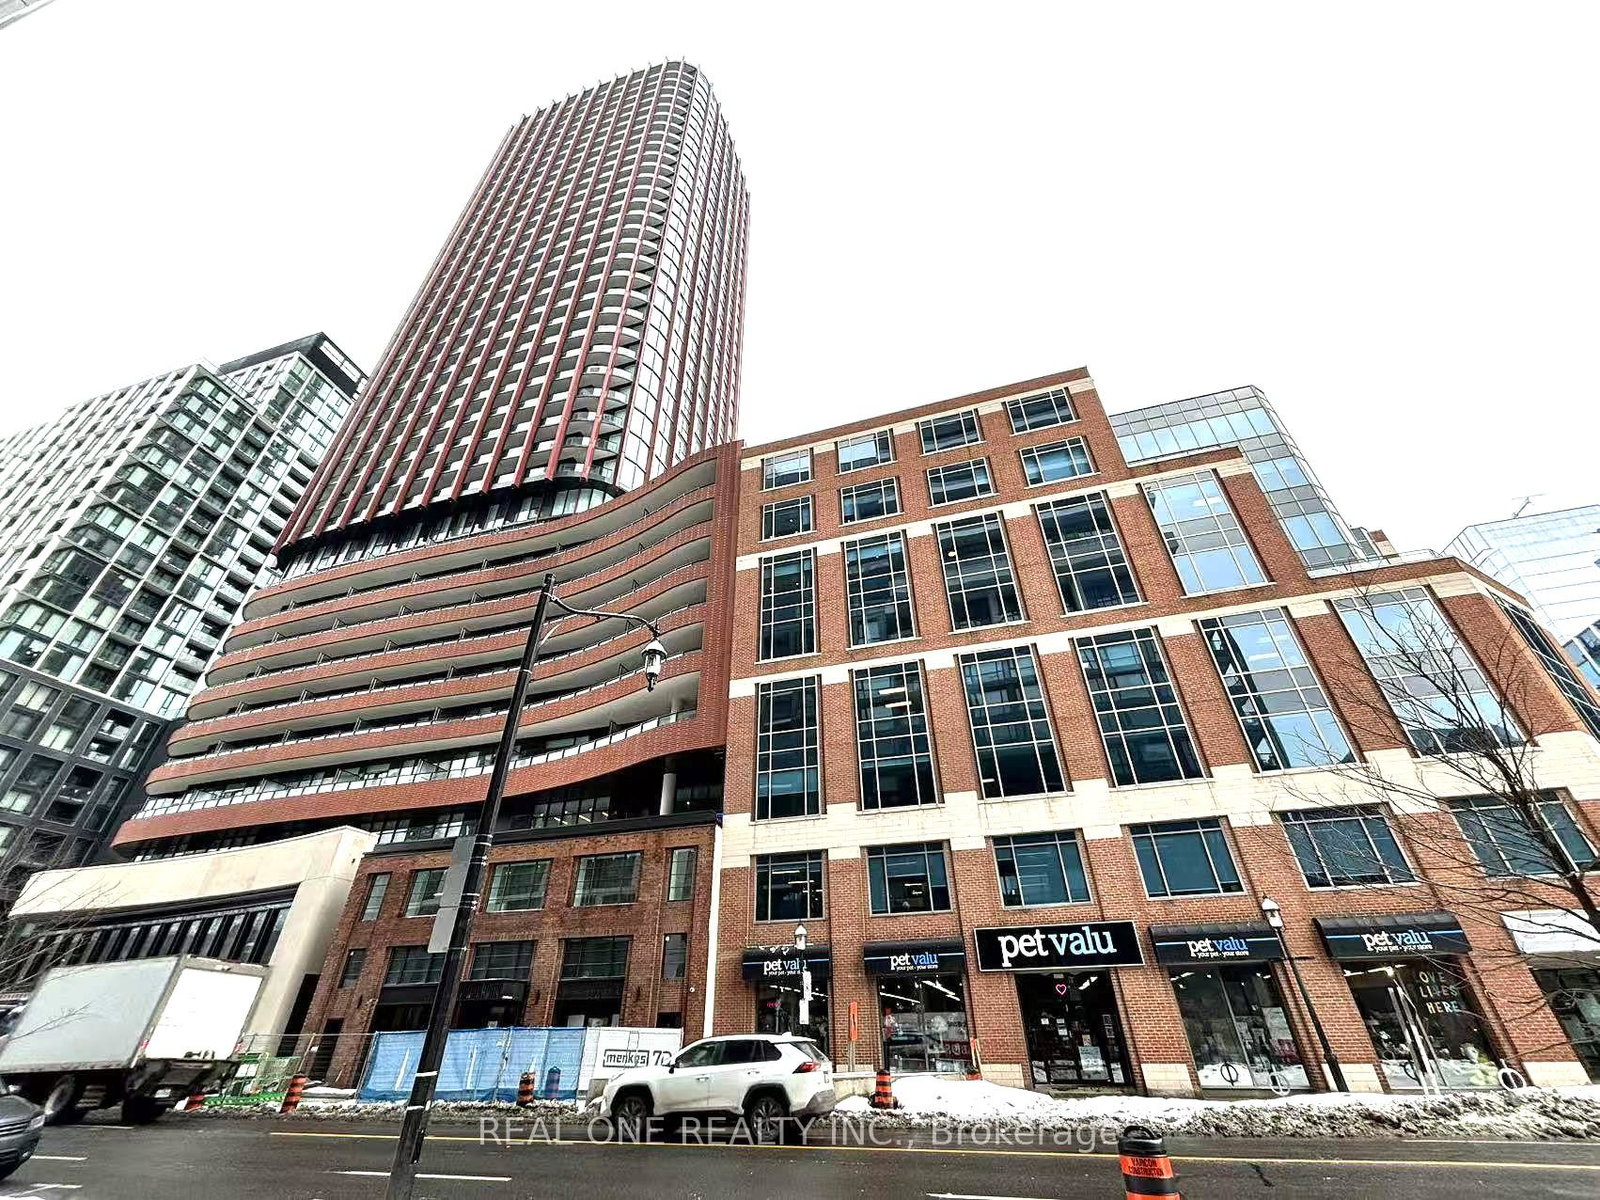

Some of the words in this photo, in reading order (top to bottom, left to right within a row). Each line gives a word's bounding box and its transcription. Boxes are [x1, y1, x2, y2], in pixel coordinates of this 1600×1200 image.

[997, 928, 1049, 968] pet
[1048, 925, 1117, 956] valu
[1186, 938, 1214, 957] pet
[1212, 936, 1248, 951] valu
[1361, 930, 1392, 952] pet
[1390, 929, 1431, 945] valu
[763, 958, 782, 976] pet
[889, 952, 911, 971] pet
[910, 951, 939, 965] valu
[1415, 971, 1446, 983] OVE
[1426, 1000, 1460, 1014] HERE
[606, 1051, 648, 1066] menkes
